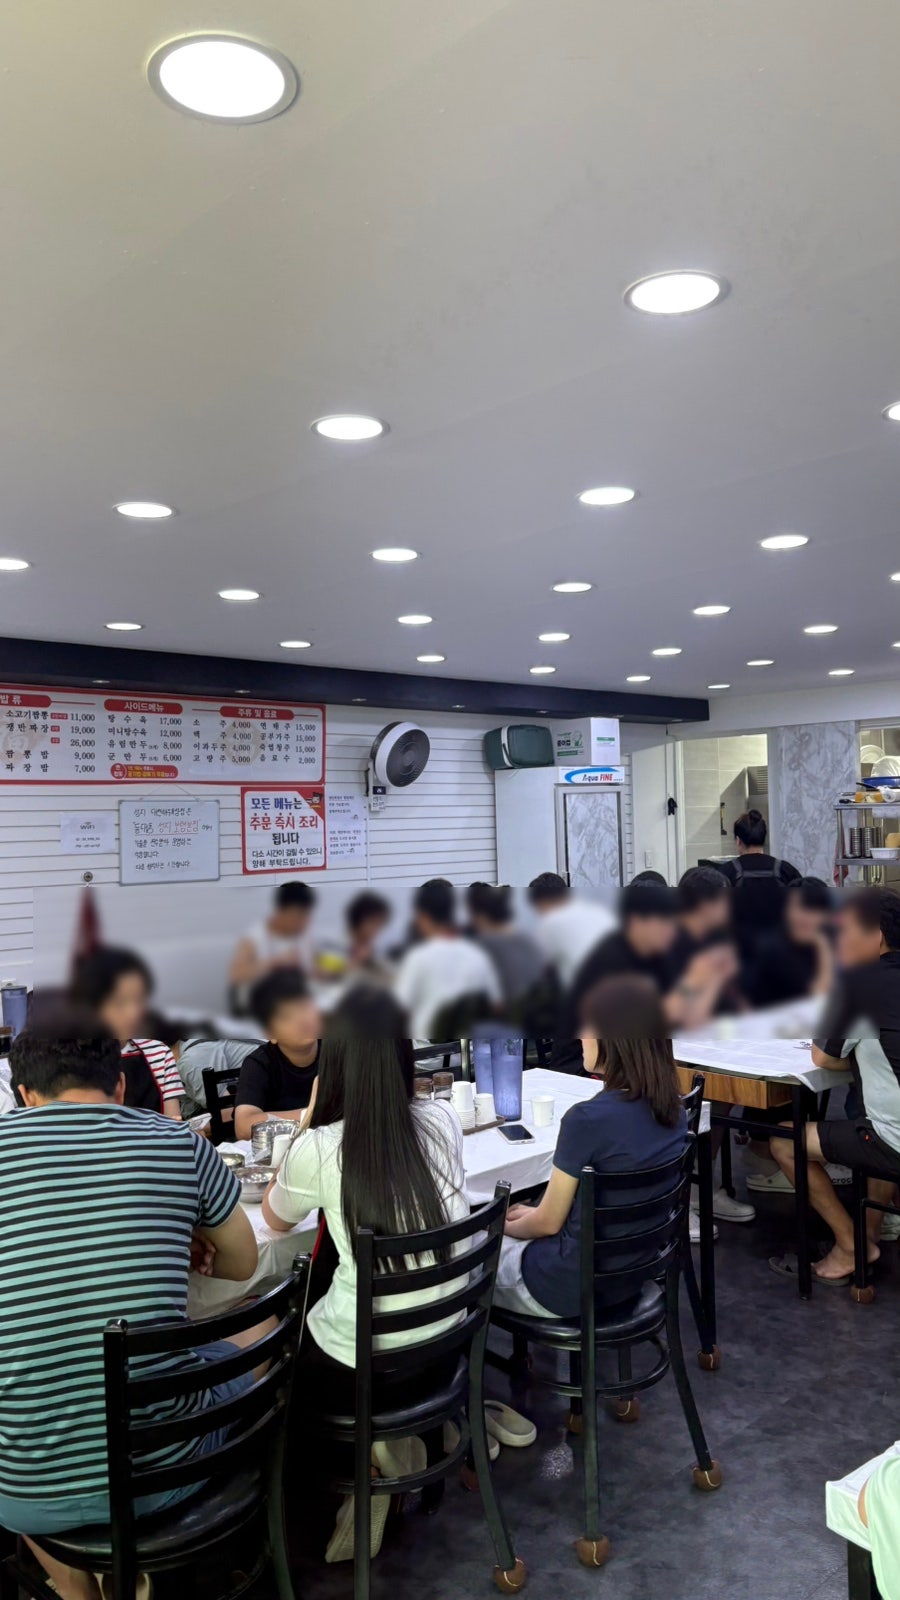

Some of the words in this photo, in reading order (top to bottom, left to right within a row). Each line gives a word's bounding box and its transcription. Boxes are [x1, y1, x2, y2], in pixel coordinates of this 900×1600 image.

[124, 702, 164, 712] 사이드메뉴
[6, 710, 49, 720] 소고기짬뽕
[70, 714, 95, 722] 11,000
[160, 718, 182, 726] 17,000
[71, 726, 95, 735] 19,000
[108, 727, 147, 736] 미니탕수육
[160, 730, 182, 738] 12,000
[70, 739, 95, 748] 26,000
[163, 742, 182, 750] 8,000
[74, 753, 95, 761] 9,000
[164, 754, 182, 762] 6,000
[232, 756, 251, 764] 5,000
[74, 765, 95, 773] 7,000
[251, 798, 270, 809] 모든
[274, 798, 302, 810] 메뉴는
[250, 815, 271, 830] 주문
[275, 815, 295, 829] 즉시
[299, 816, 318, 828] 조리
[272, 832, 300, 845] 됩니다
[252, 850, 264, 858] 다소
[266, 849, 284, 857] 시간이
[286, 848, 298, 856] 걸릴
[306, 847, 322, 855] 있으니
[252, 860, 266, 868] 양해
